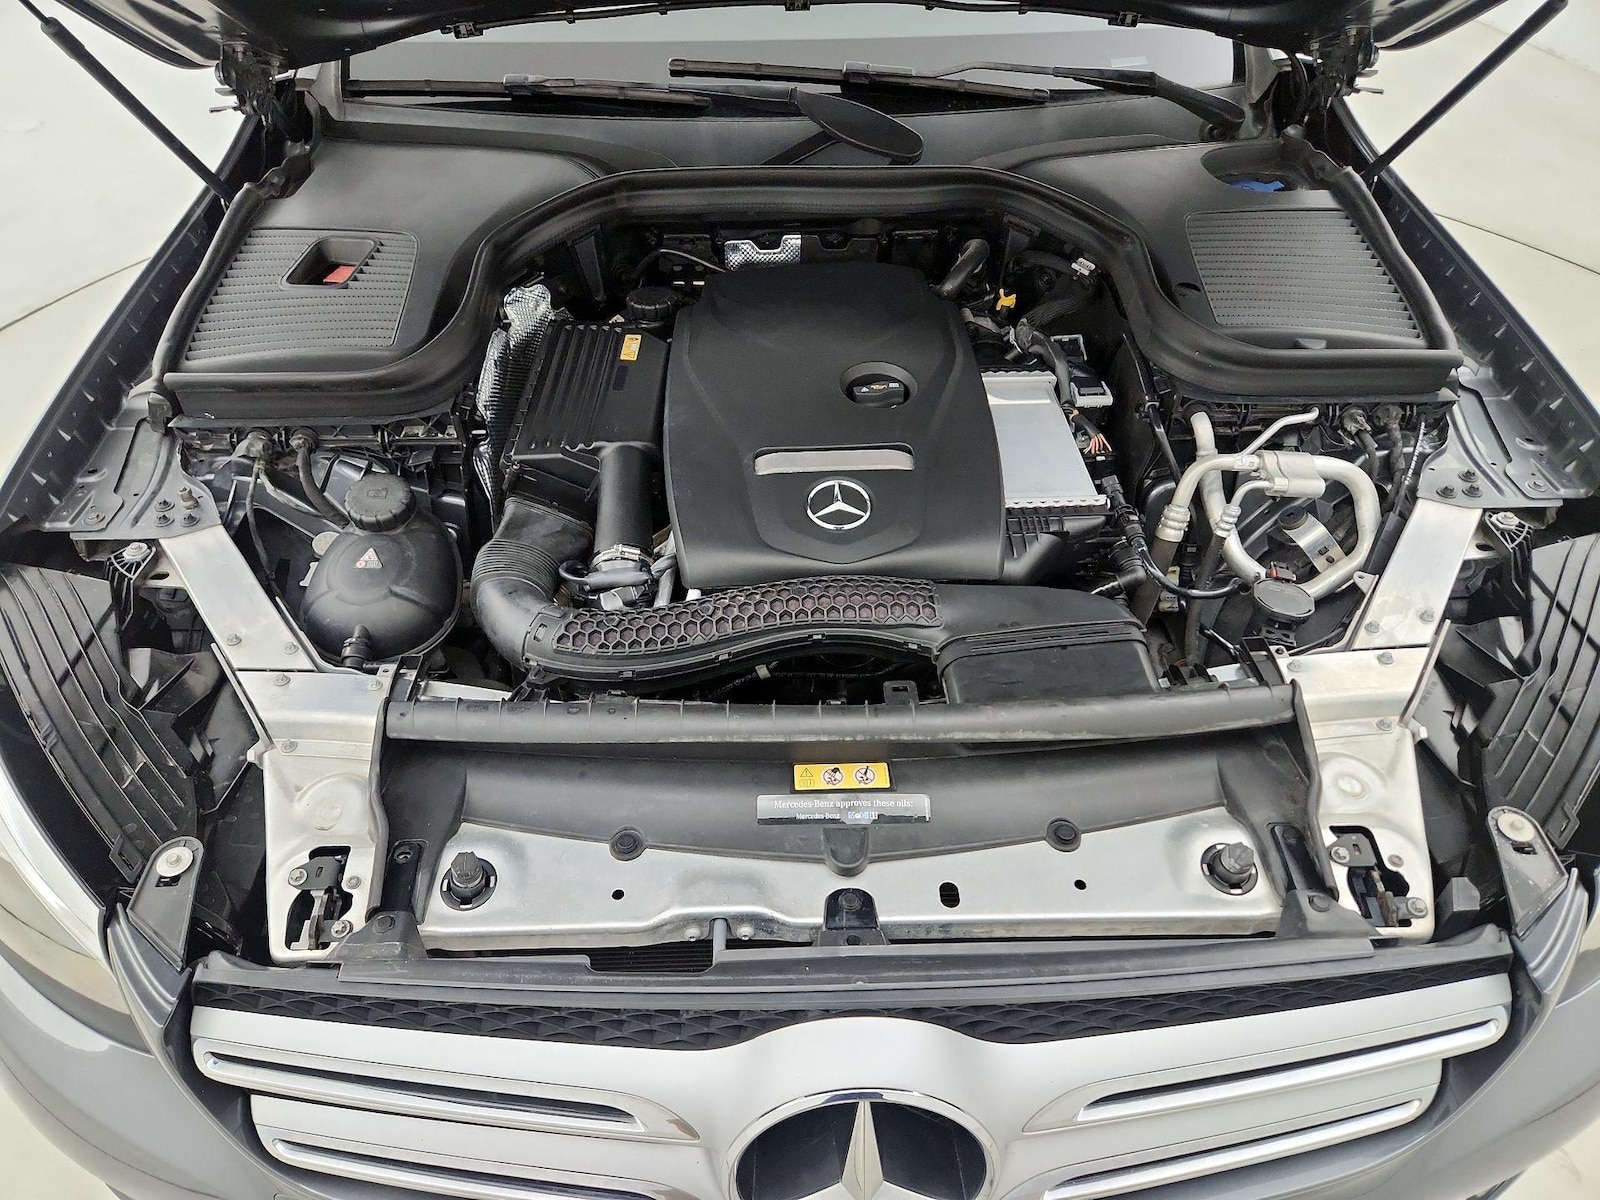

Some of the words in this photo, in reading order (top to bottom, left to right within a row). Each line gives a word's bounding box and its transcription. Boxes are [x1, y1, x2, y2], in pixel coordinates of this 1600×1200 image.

[774, 800, 834, 808] Mercedes-Benz
[835, 800, 872, 809] approves
[873, 799, 895, 807] these
[896, 799, 914, 807] oils:
[795, 812, 841, 820] Mercedes-Benz
